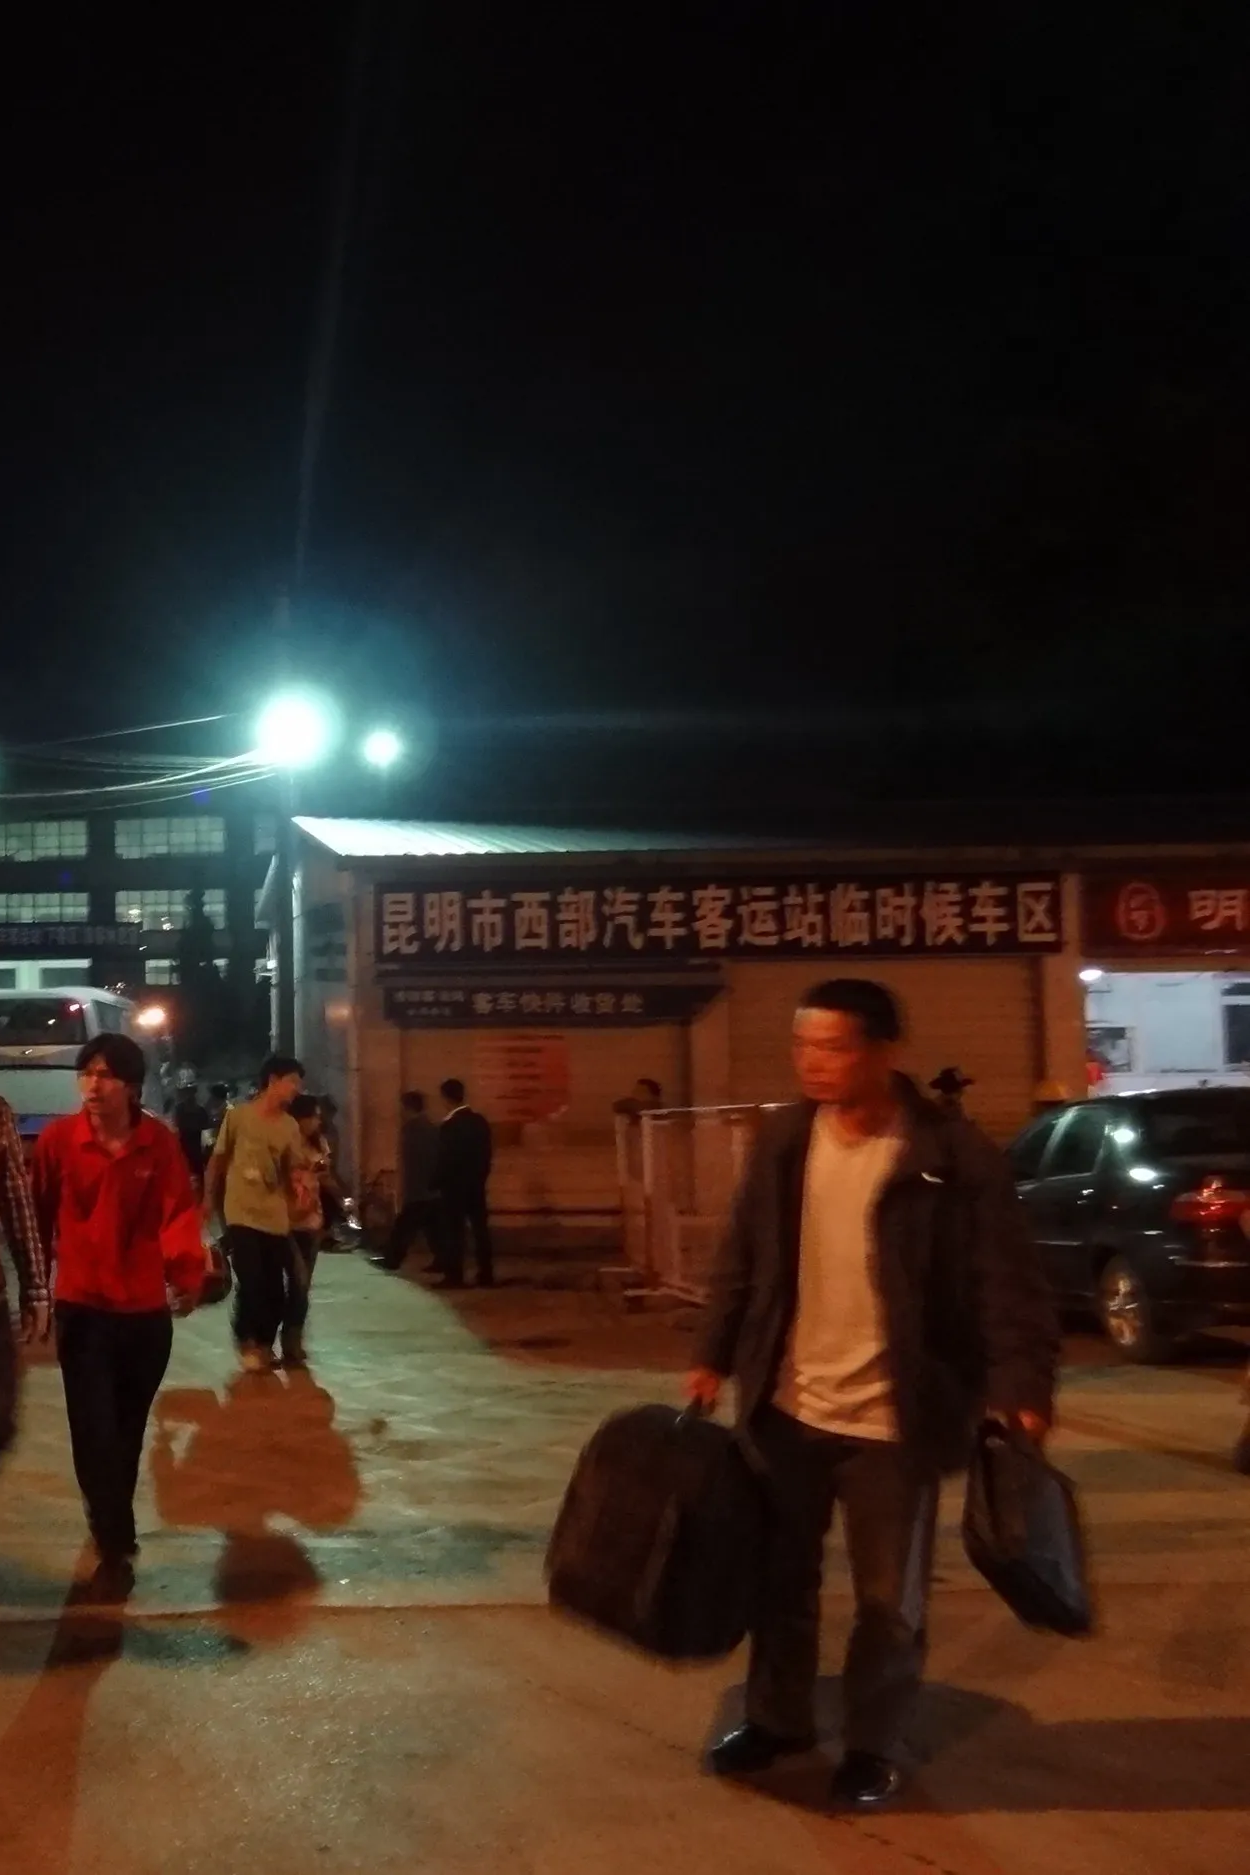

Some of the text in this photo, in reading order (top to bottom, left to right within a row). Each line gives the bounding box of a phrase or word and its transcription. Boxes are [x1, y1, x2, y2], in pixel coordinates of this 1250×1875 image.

[382, 882, 1058, 954] 昆明市西部汽车客运站临时候车区
[1187, 888, 1249, 931] 明
